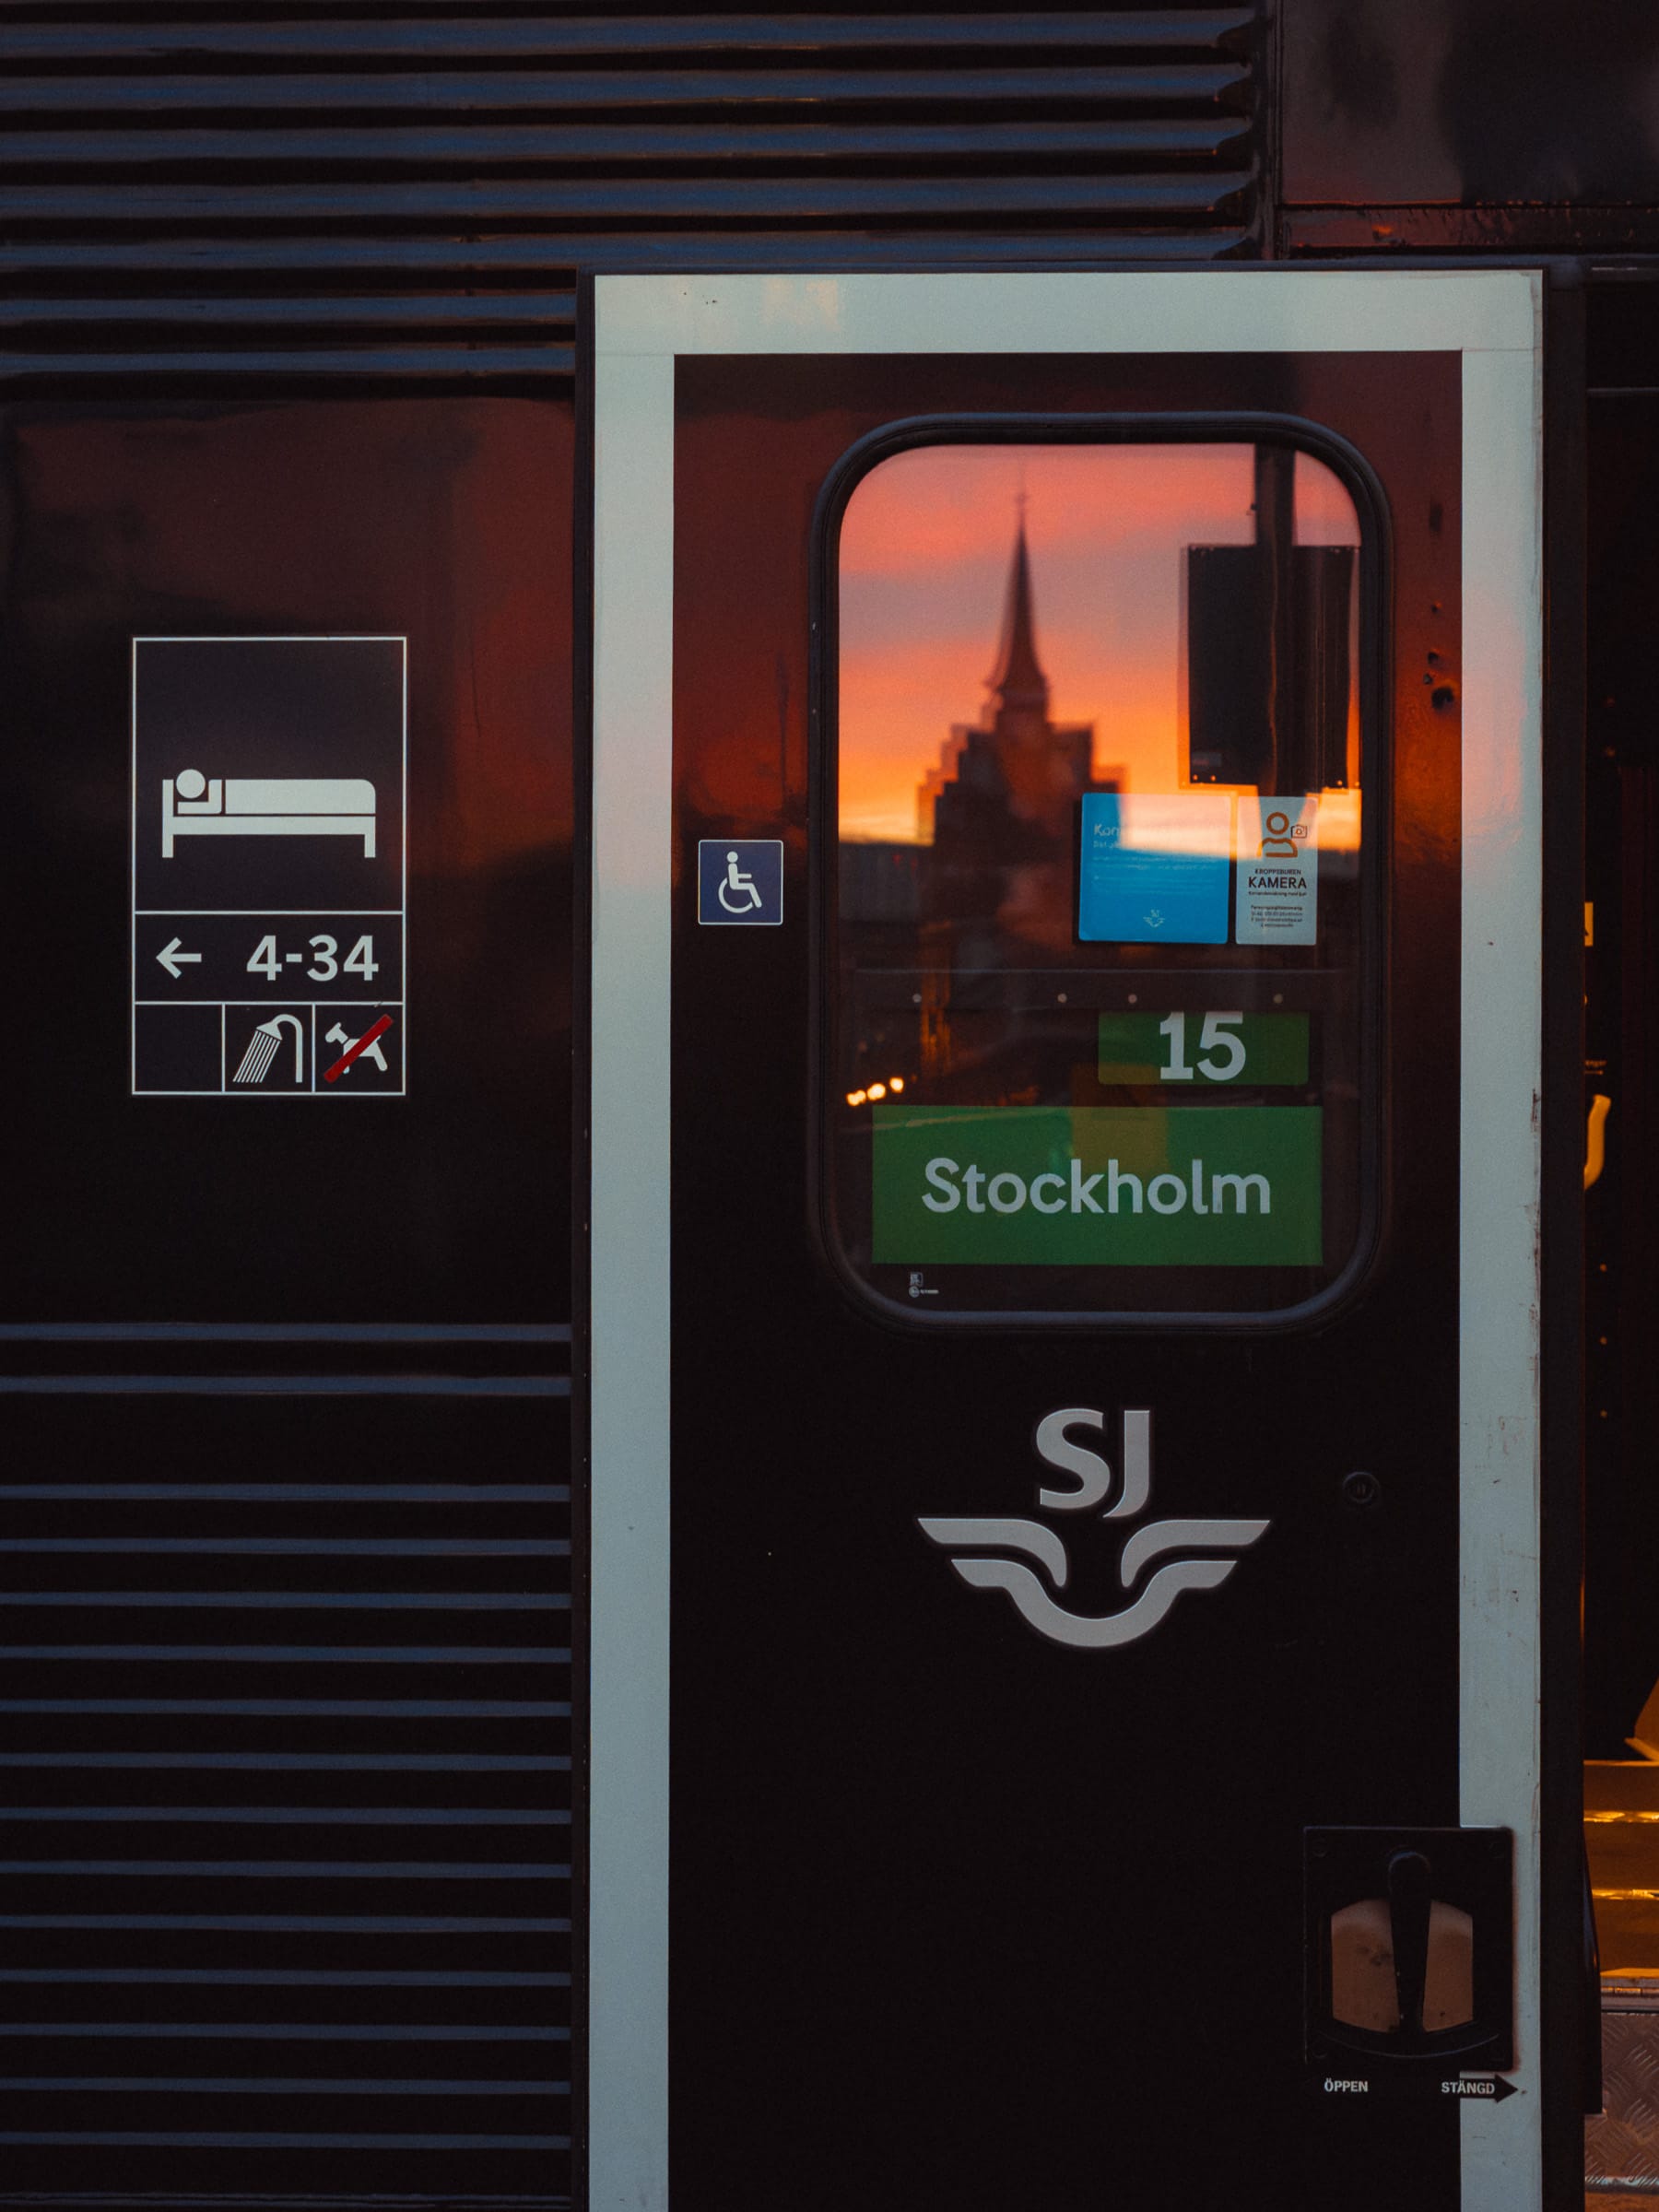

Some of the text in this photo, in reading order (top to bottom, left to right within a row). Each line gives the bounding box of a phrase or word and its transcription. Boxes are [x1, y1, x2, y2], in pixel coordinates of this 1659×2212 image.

[1248, 877, 1307, 888] KAMERA
[246, 934, 379, 982] 4-34
[1159, 1011, 1246, 1081] 15
[922, 1157, 1271, 1215] Stockholm
[1036, 1408, 1150, 1518] SJ
[1324, 2077, 1496, 2095] ÖPPEN STÄNGD
